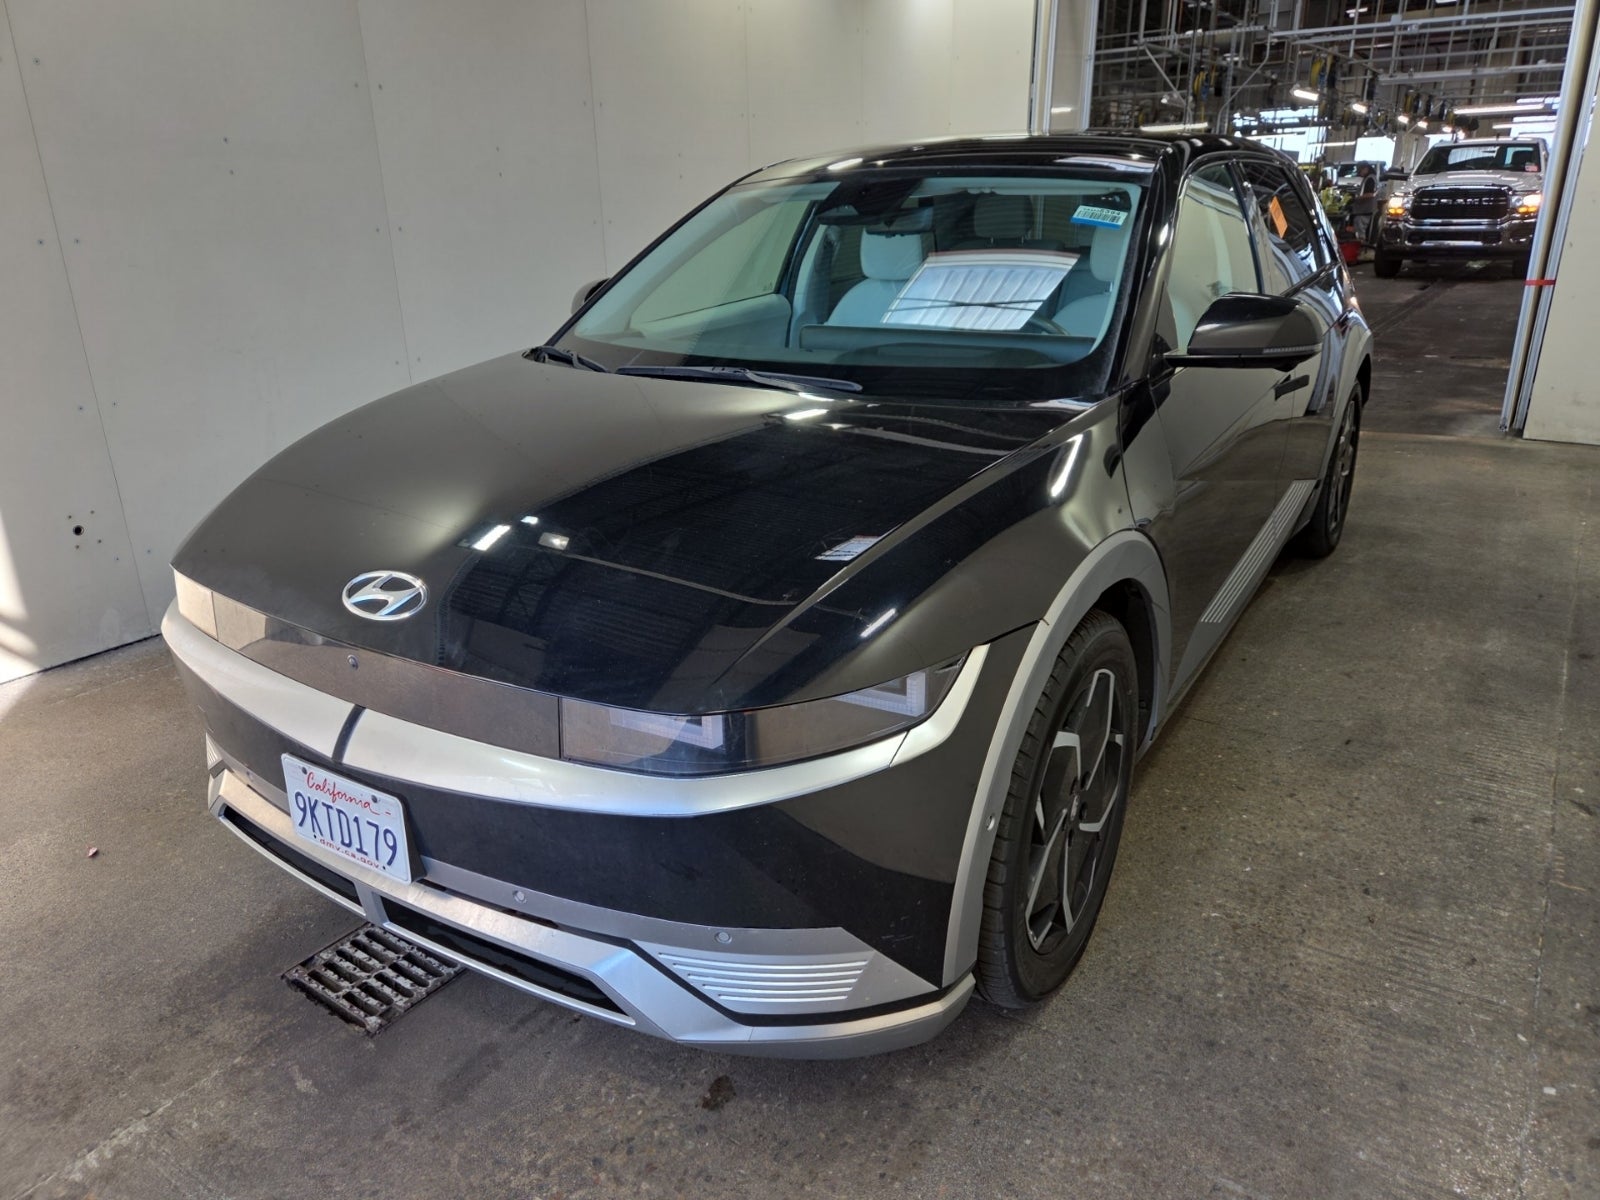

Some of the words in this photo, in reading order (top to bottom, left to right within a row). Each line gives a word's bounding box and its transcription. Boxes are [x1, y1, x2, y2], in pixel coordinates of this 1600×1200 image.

[307, 771, 380, 815] California
[295, 791, 397, 867] 9KTD179
[319, 838, 379, 869] dmv.ca.gov
